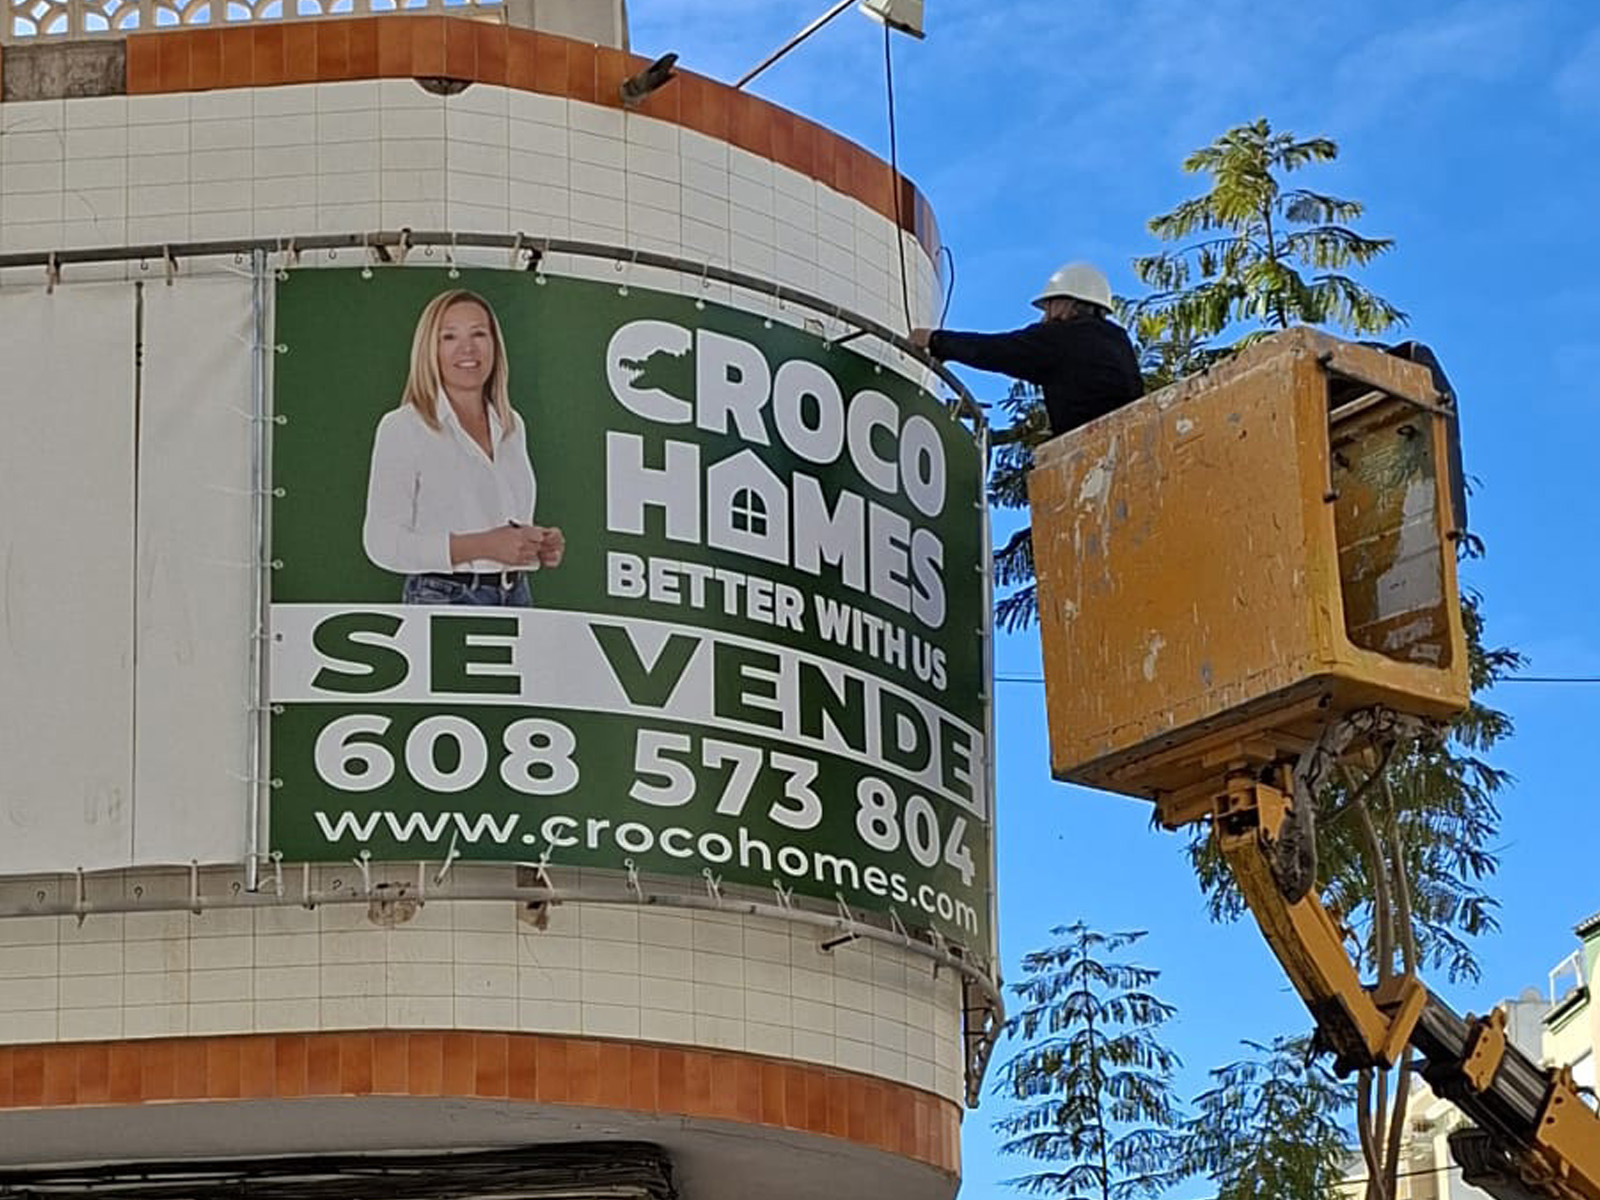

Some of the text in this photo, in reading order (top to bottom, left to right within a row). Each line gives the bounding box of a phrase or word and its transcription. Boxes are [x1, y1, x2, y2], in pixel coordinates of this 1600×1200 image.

[606, 320, 946, 518] CROCO
[606, 430, 946, 629] HOMES
[311, 612, 974, 804] SE VENDE
[607, 551, 948, 691] BETTER WITH US
[314, 714, 976, 886] 608 573 804
[315, 810, 979, 935] www.crocohomes.com
